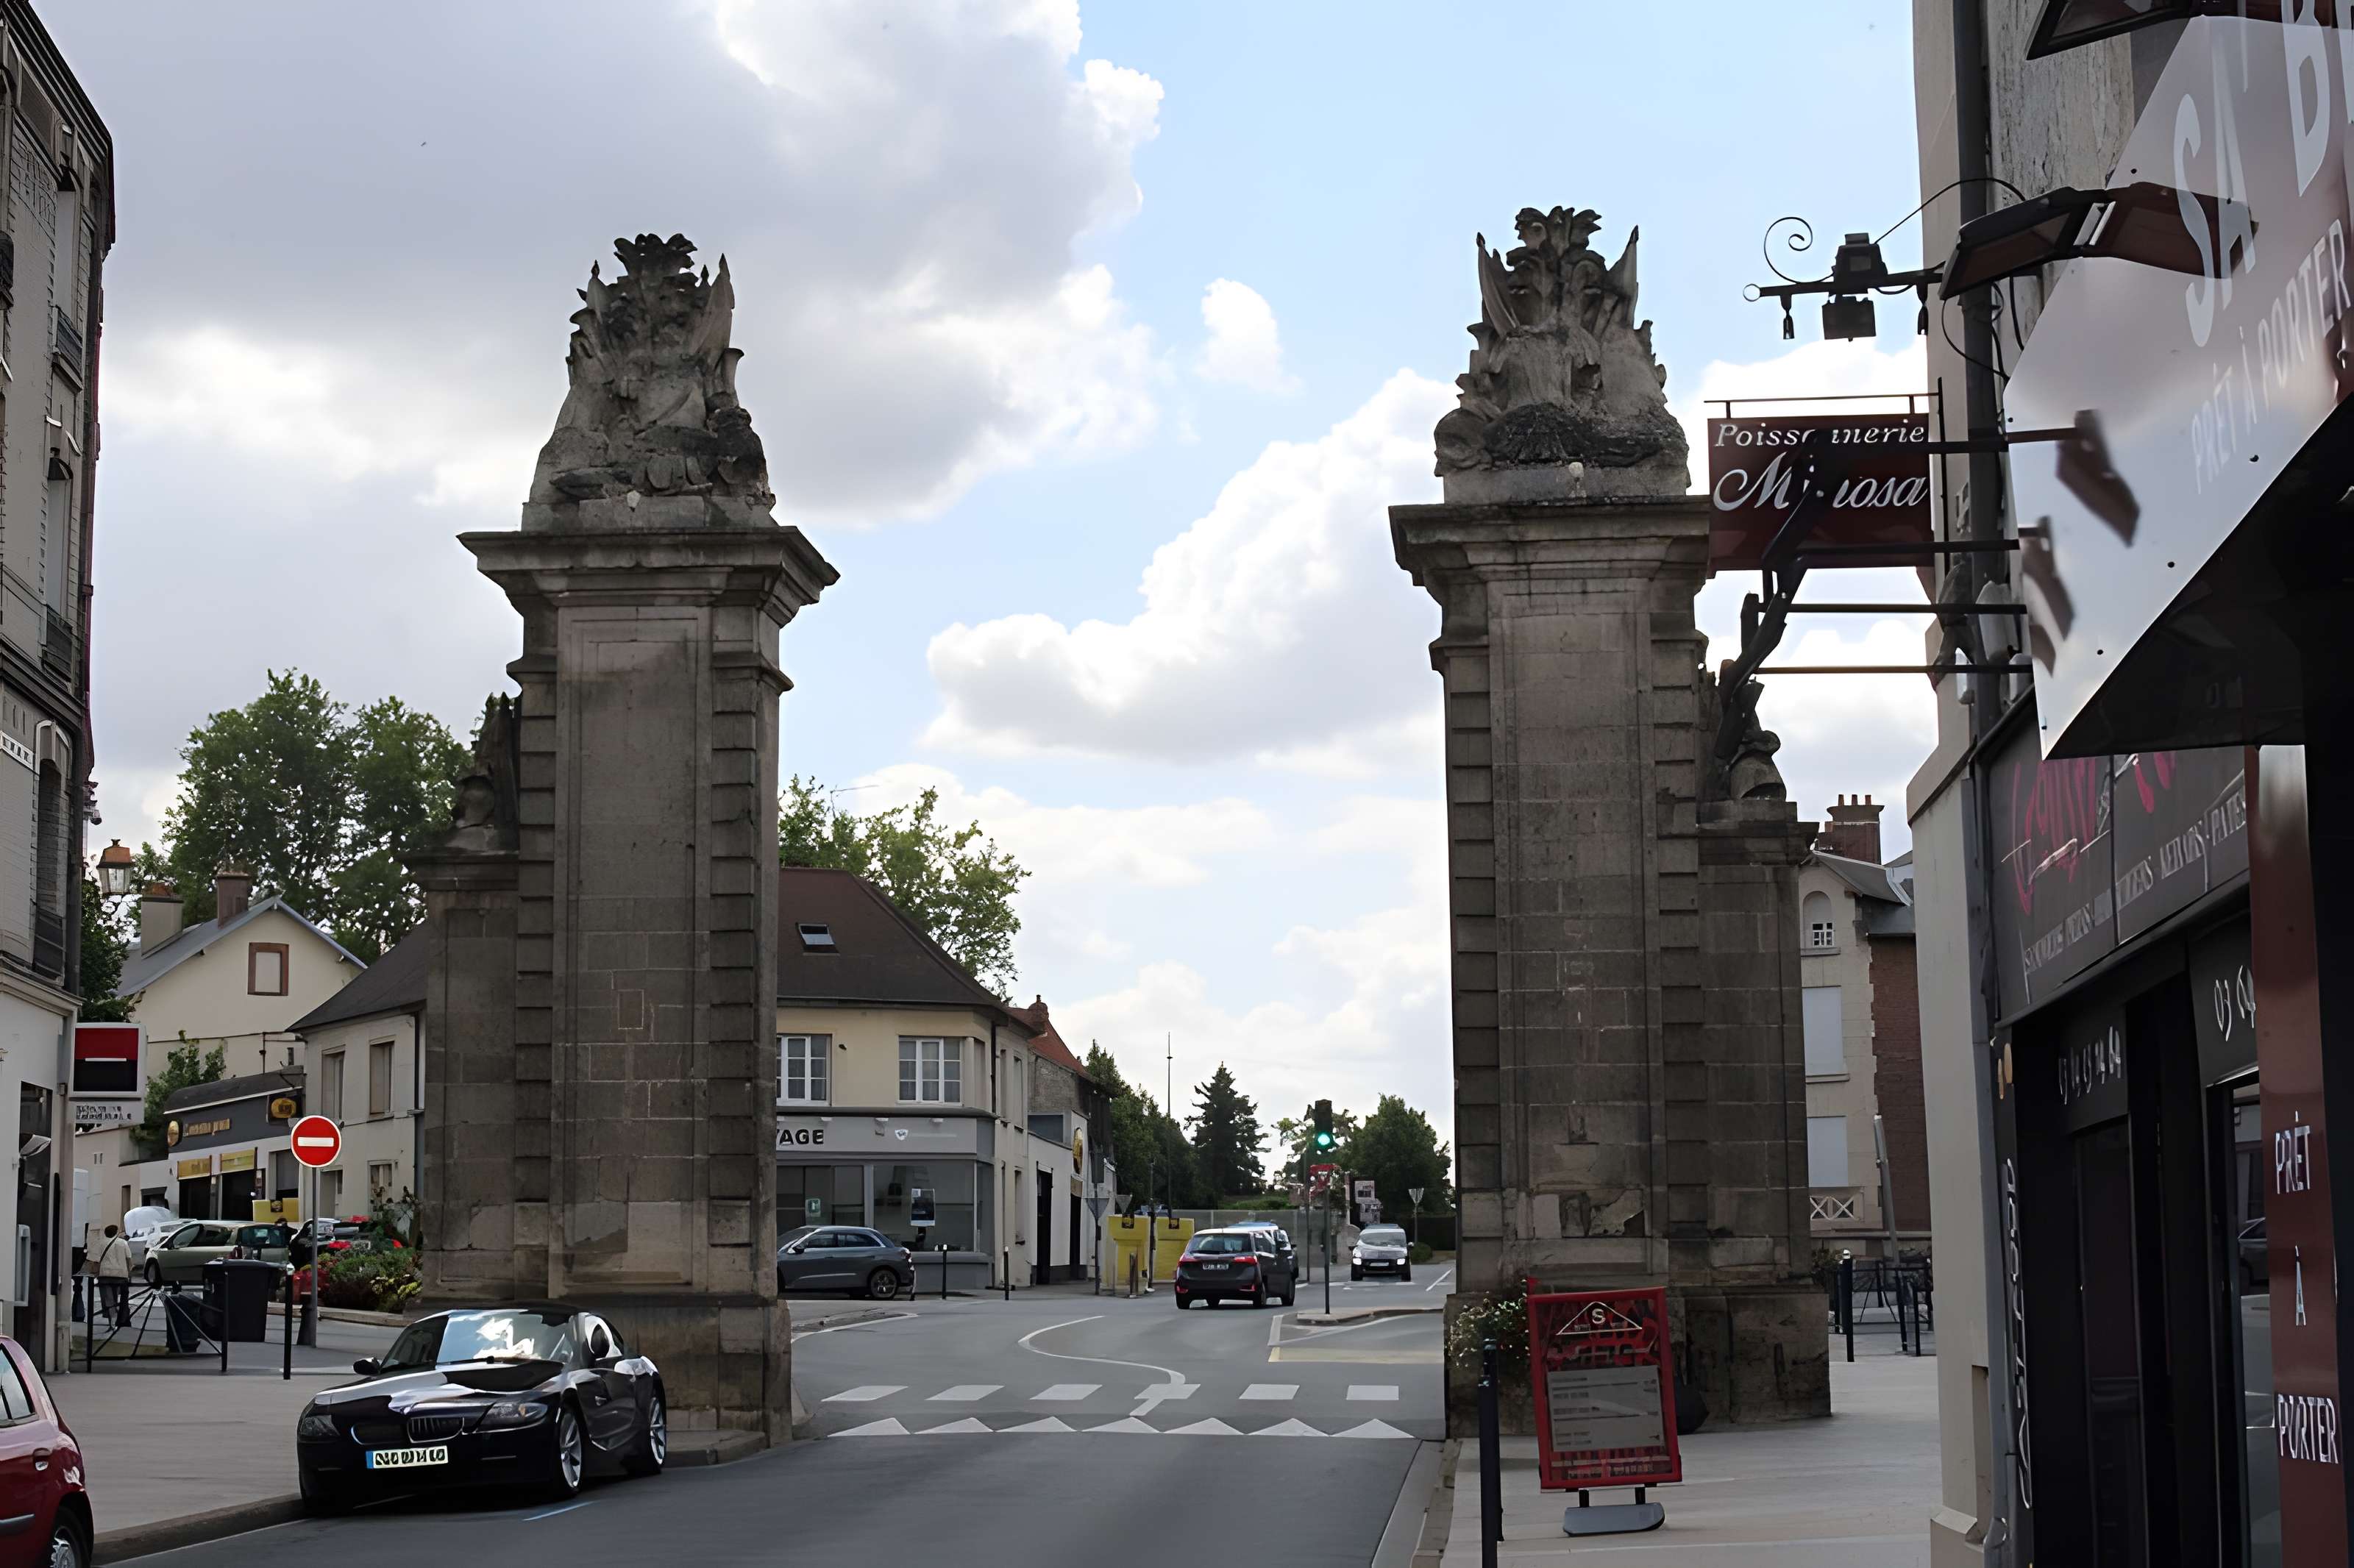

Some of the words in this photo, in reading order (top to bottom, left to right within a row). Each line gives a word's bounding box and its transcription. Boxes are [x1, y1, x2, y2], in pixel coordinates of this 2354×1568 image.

[2258, 218, 2351, 413] PORTER
[1713, 418, 1925, 447] Poissnerie
[776, 1129, 825, 1146] AGE
[2278, 1393, 2339, 1464] PORTER
